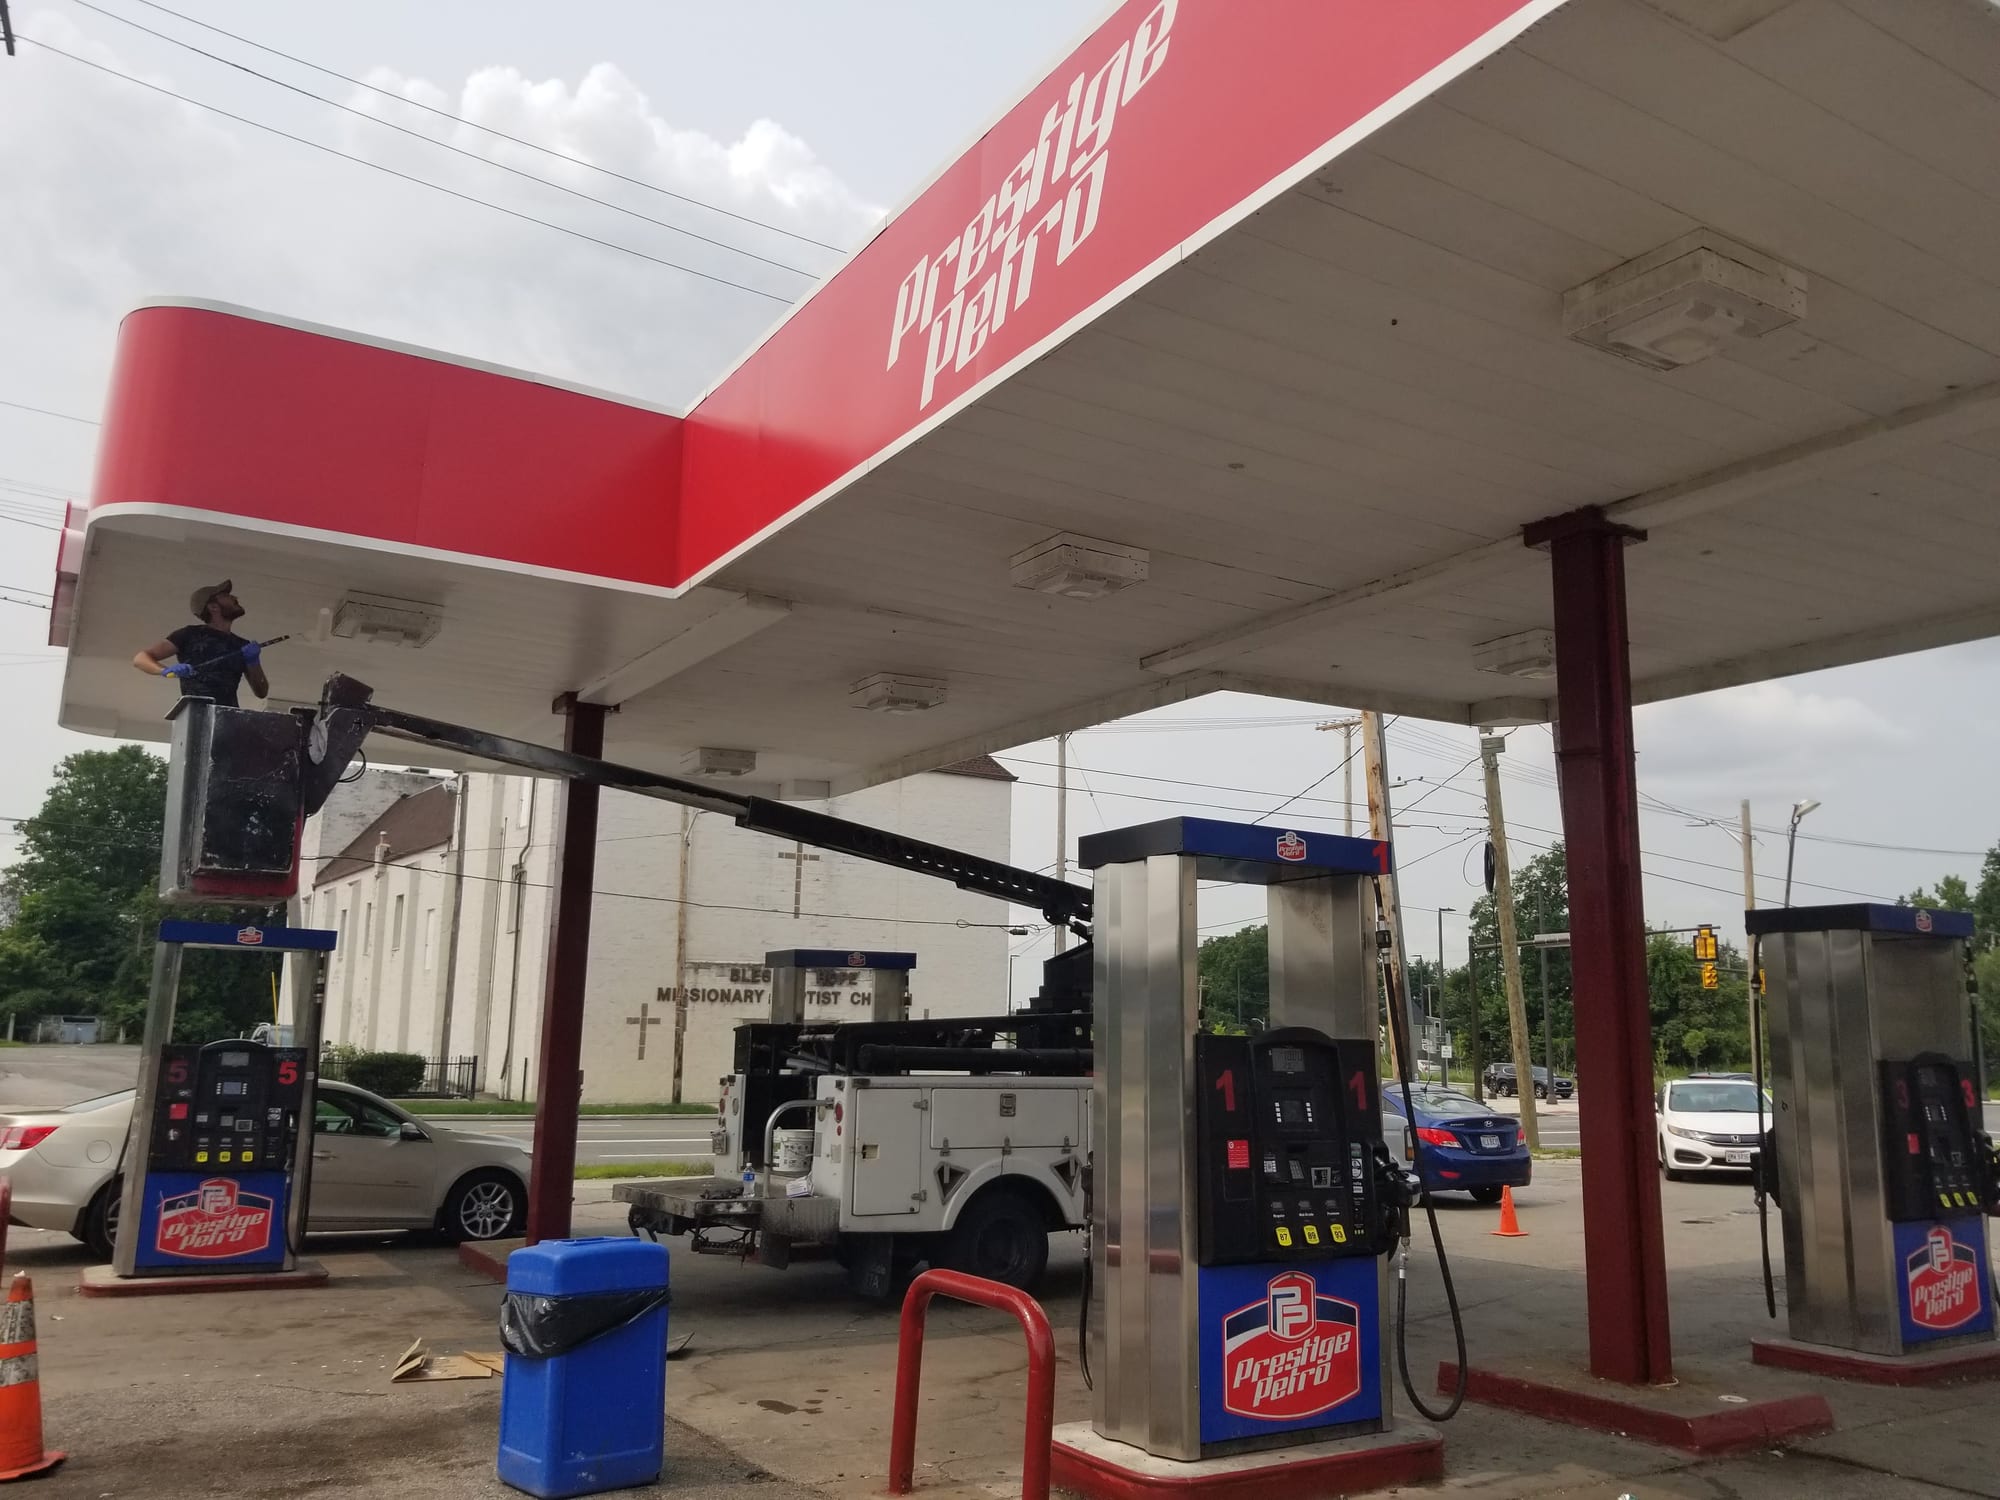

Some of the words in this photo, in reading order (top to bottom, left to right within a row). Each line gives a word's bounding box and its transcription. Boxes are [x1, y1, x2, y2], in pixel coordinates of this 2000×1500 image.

[886, 0, 1179, 371] Prestige
[920, 149, 1108, 411] Petro
[1372, 841, 1389, 874] 1
[168, 1060, 188, 1083] 5
[278, 1061, 298, 1085] 5
[1216, 1069, 1236, 1112] 1
[1348, 1071, 1367, 1111] 1
[1960, 1079, 1975, 1108] 3
[165, 1212, 266, 1240] Prestige
[179, 1227, 247, 1251] Petro
[1279, 1233, 1288, 1241] 87
[1232, 1330, 1352, 1390] Prestige
[1252, 1361, 1332, 1408] Petro
